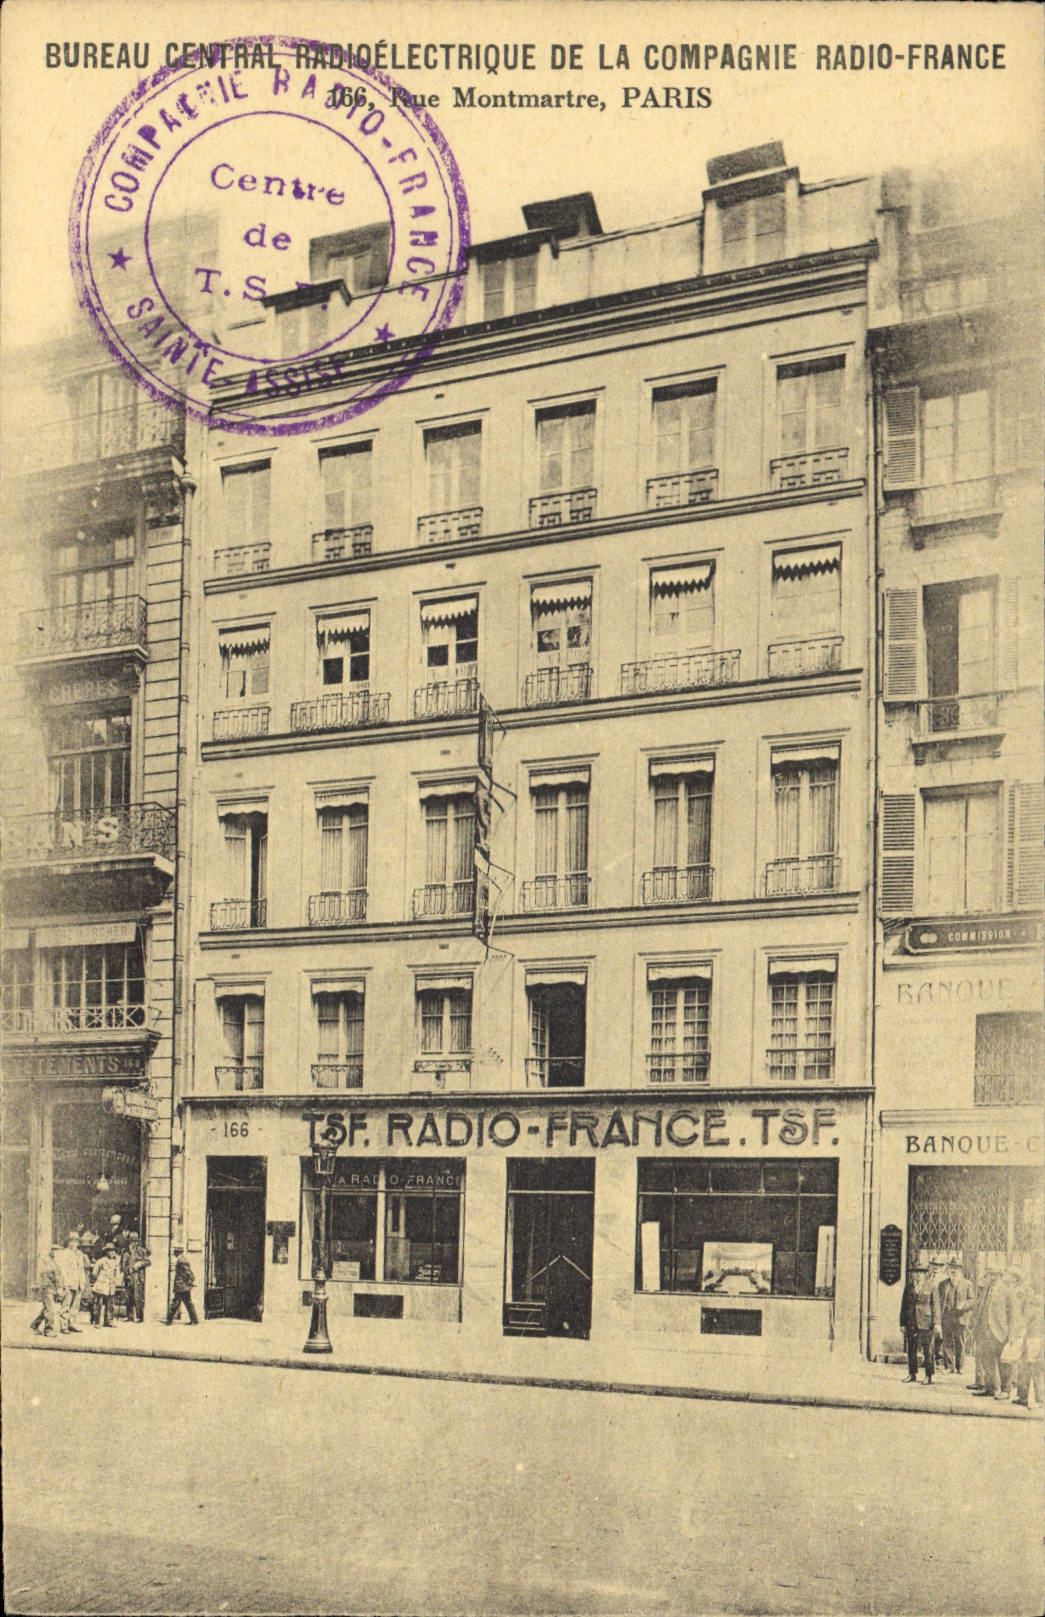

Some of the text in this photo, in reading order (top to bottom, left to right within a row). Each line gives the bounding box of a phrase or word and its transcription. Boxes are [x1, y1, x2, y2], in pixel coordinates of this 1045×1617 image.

[896, 978, 1014, 1004] BANQUE
[223, 1121, 249, 1138] 166
[302, 1112, 370, 1148] TSF.
[752, 1107, 840, 1146] TSF.
